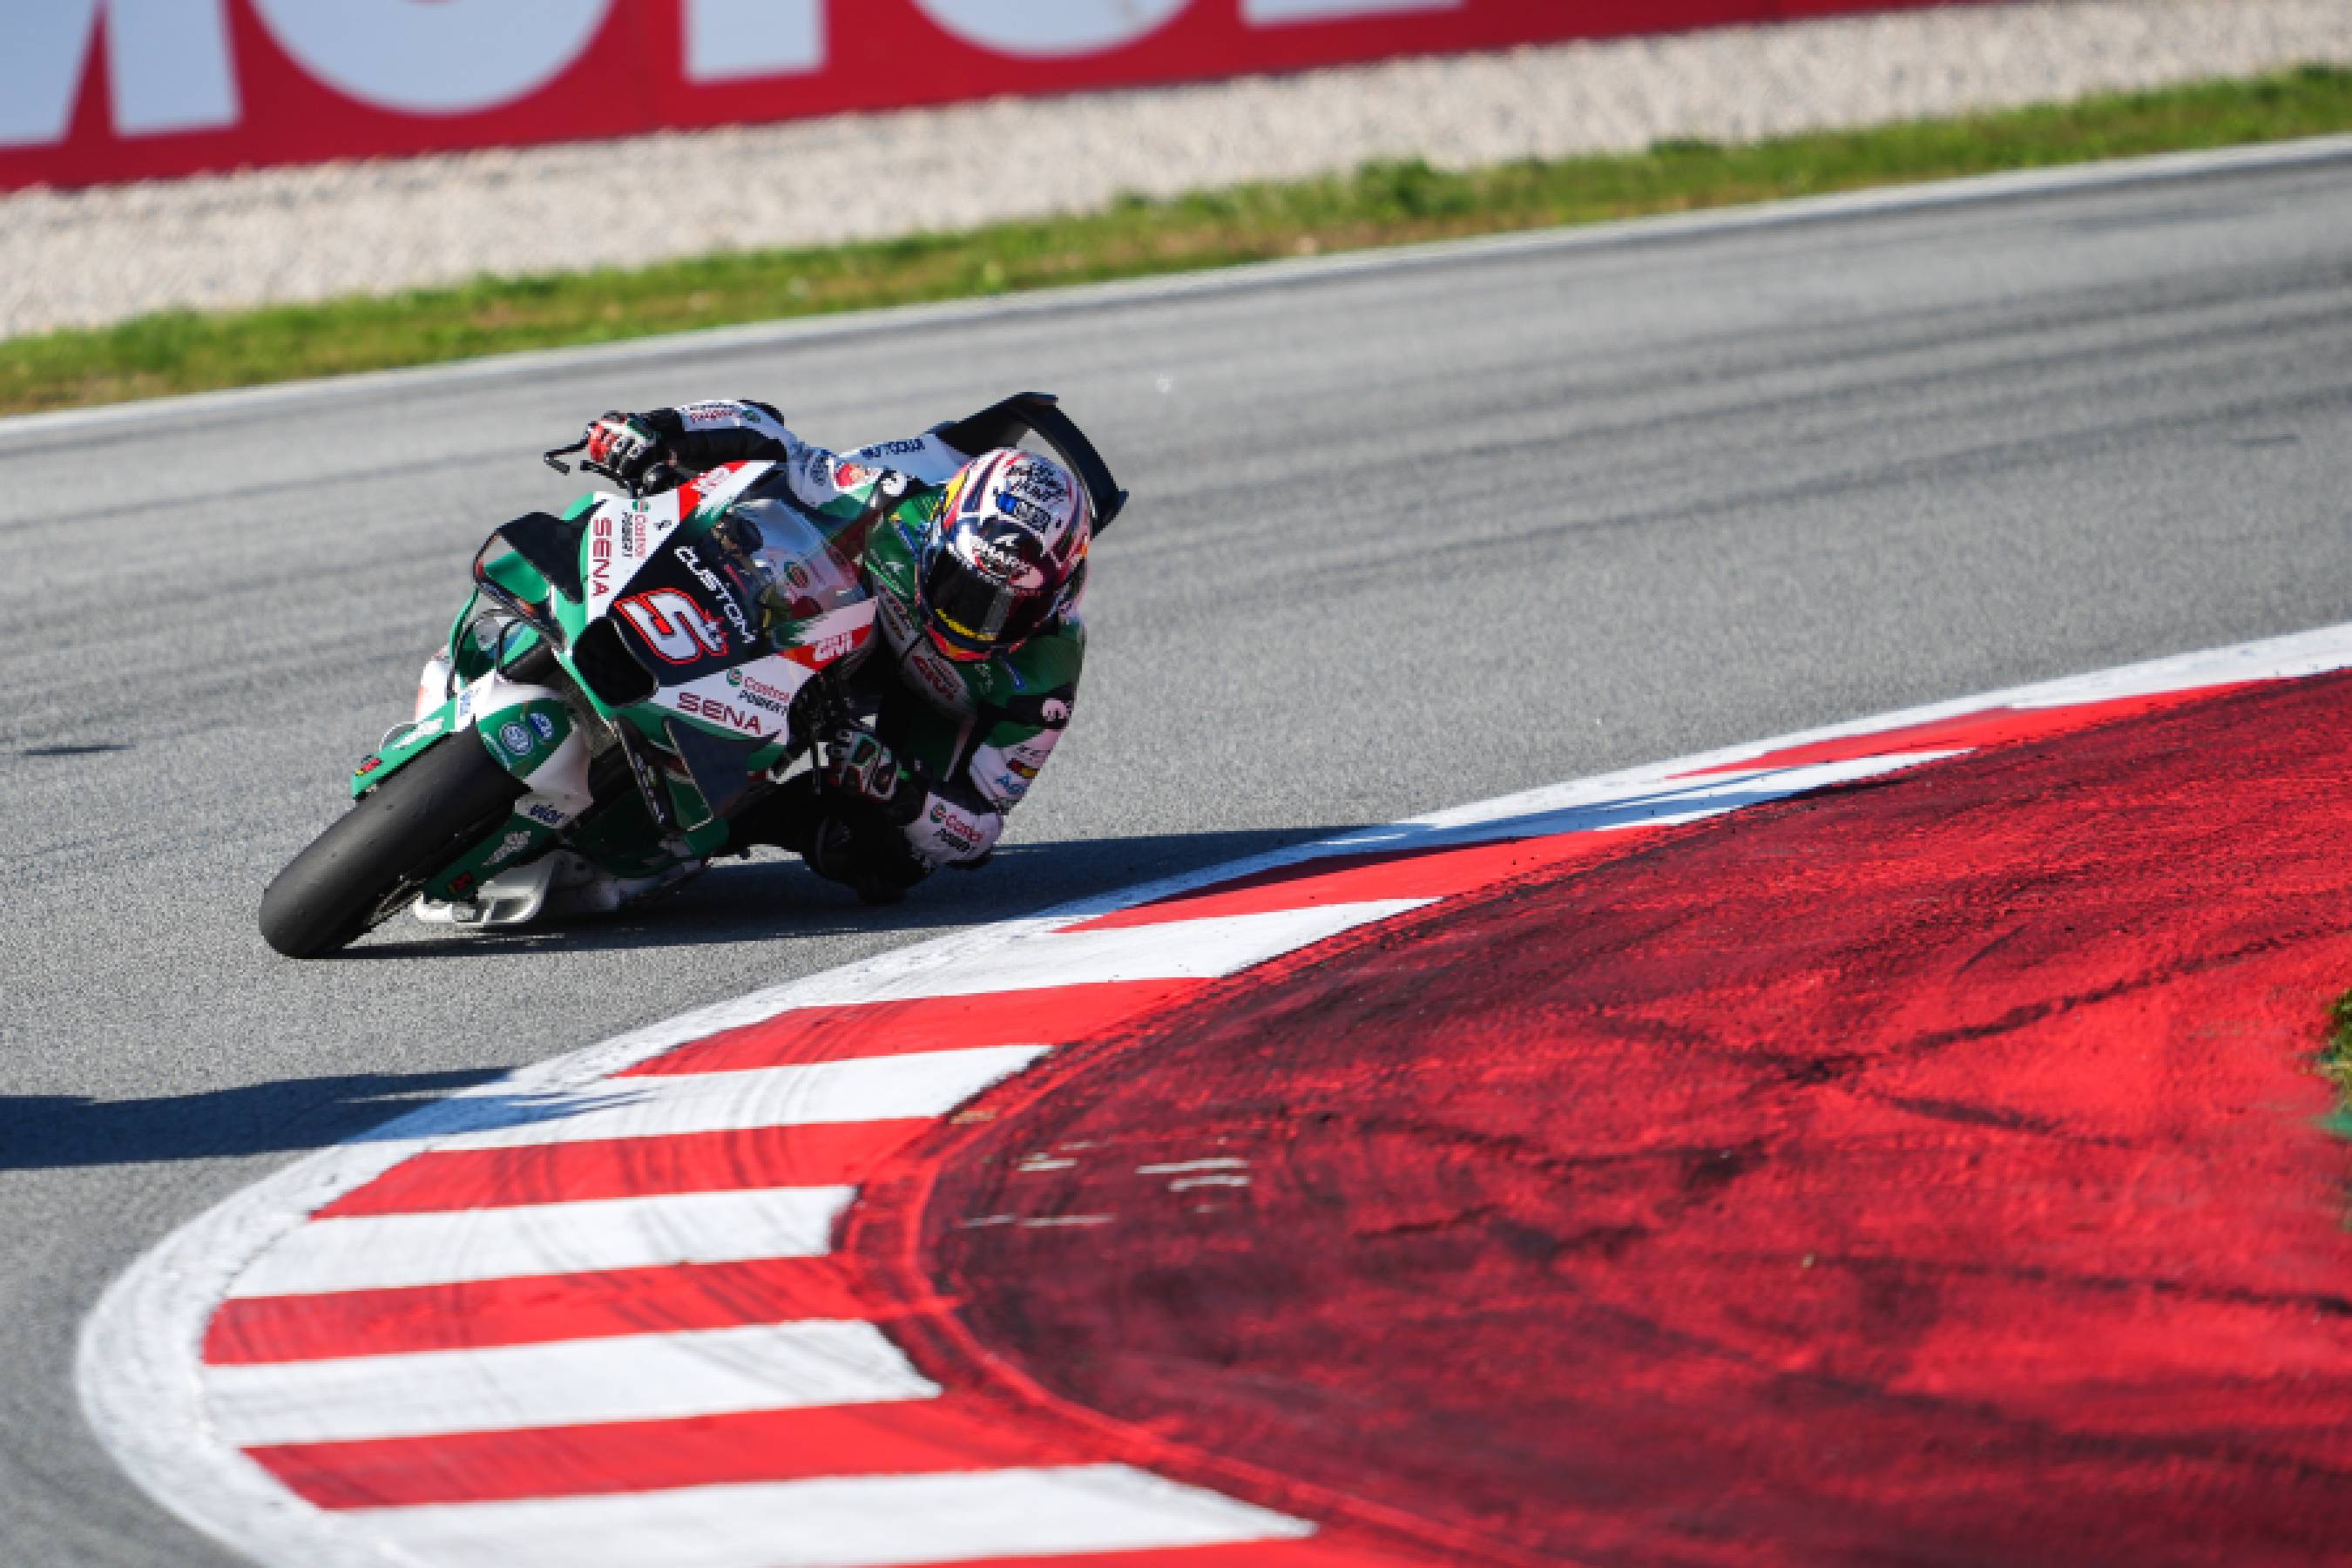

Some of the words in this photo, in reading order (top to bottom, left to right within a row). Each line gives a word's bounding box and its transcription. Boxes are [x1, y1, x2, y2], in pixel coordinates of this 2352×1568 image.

[592, 517, 612, 598] SENA
[634, 515, 647, 558] Castrol
[673, 545, 756, 645] CUSTOM
[613, 587, 729, 665] 5
[813, 629, 854, 663] GIVI
[737, 688, 788, 716] POWER1
[743, 676, 791, 704] Castrol
[676, 692, 762, 735] SENA
